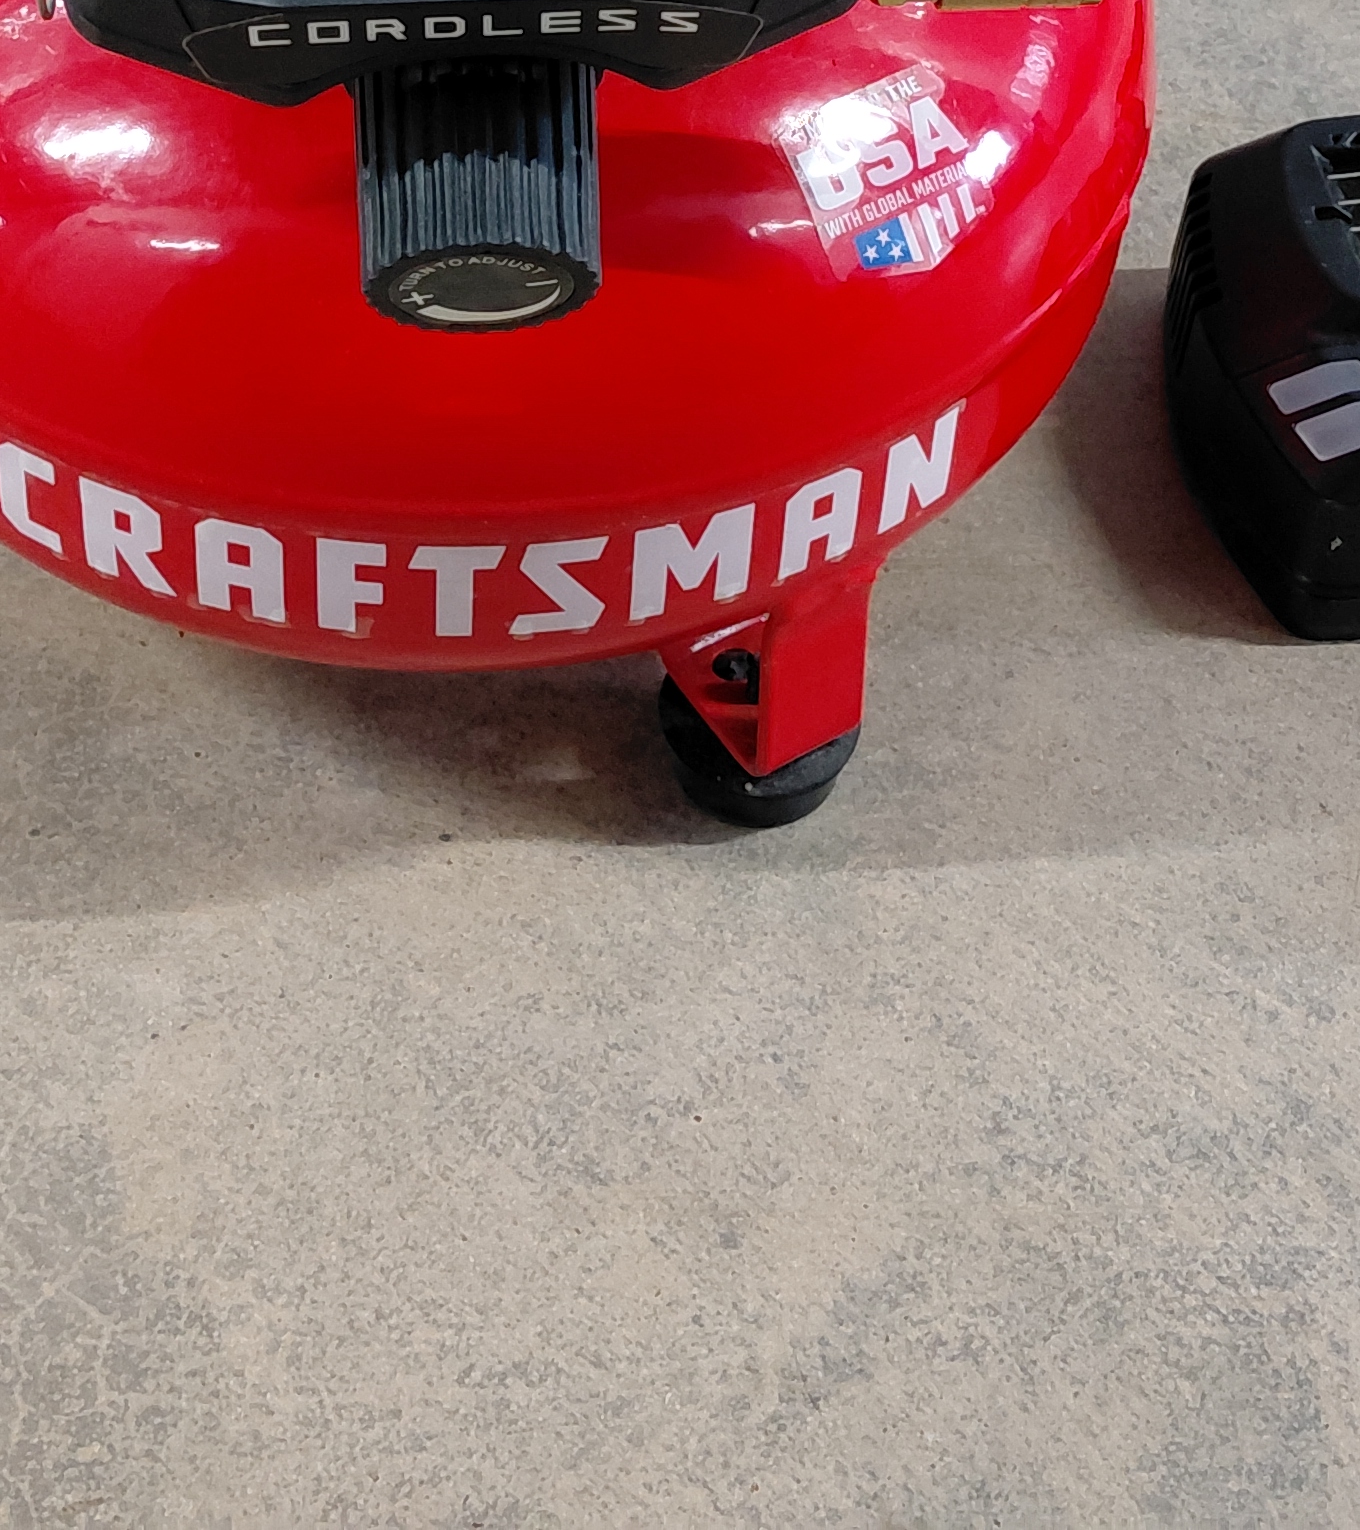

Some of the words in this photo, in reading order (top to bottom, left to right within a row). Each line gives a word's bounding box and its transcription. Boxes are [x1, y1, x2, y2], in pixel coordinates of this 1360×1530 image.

[248, 8, 701, 47] CORDLESS
[884, 74, 924, 103] THE
[796, 95, 970, 211] USA
[824, 209, 864, 240] WITH
[862, 187, 915, 222] GLOBAL
[398, 265, 437, 292] TURN
[436, 257, 464, 270] TO
[467, 256, 548, 275] ADJUST
